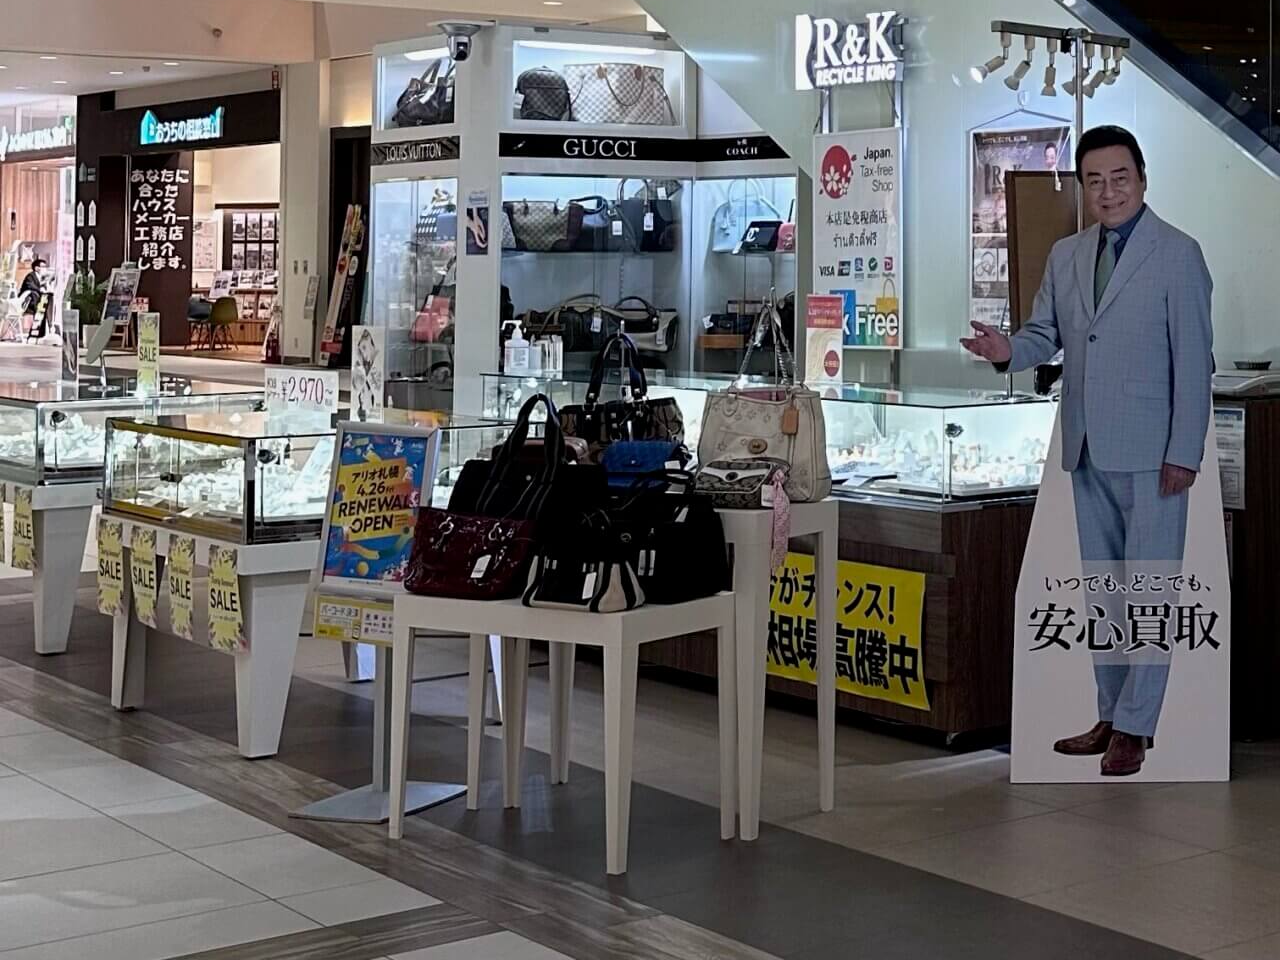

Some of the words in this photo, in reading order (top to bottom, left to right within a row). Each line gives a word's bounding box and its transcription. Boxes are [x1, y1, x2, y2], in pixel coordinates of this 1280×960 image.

[813, 10, 898, 69] R&K
[816, 66, 865, 87] RECYCLE
[866, 62, 896, 82] KING
[386, 144, 408, 162] LOUIS
[408, 142, 442, 160] VUITTON
[563, 138, 637, 158] GUCCI
[726, 146, 758, 156] COACH
[131, 169, 190, 184] あなたに
[859, 164, 894, 177] Tax-free
[139, 185, 179, 198] 合った
[871, 178, 894, 193] Shop
[132, 198, 176, 212] ハウス
[135, 213, 190, 224] メーカー
[134, 225, 185, 241] 工務店
[141, 241, 176, 257] 紹介
[138, 256, 187, 271] します。
[819, 265, 836, 277] VISA
[855, 305, 898, 337] Free
[138, 346, 157, 362] SALE
[352, 465, 400, 483] アリオ札幌
[338, 494, 411, 519] RENEWAL
[14, 520, 33, 540] SALE
[349, 514, 394, 534] OPEN
[99, 558, 122, 581] SALE
[132, 565, 155, 590] SALE
[169, 575, 192, 601] SALE
[1044, 573, 1212, 592] いつでも、どこでも、
[210, 587, 239, 612] SALE
[769, 567, 896, 625] がチンス!
[1027, 601, 1221, 652] 安心買取
[766, 610, 919, 694] 相場高騰中
